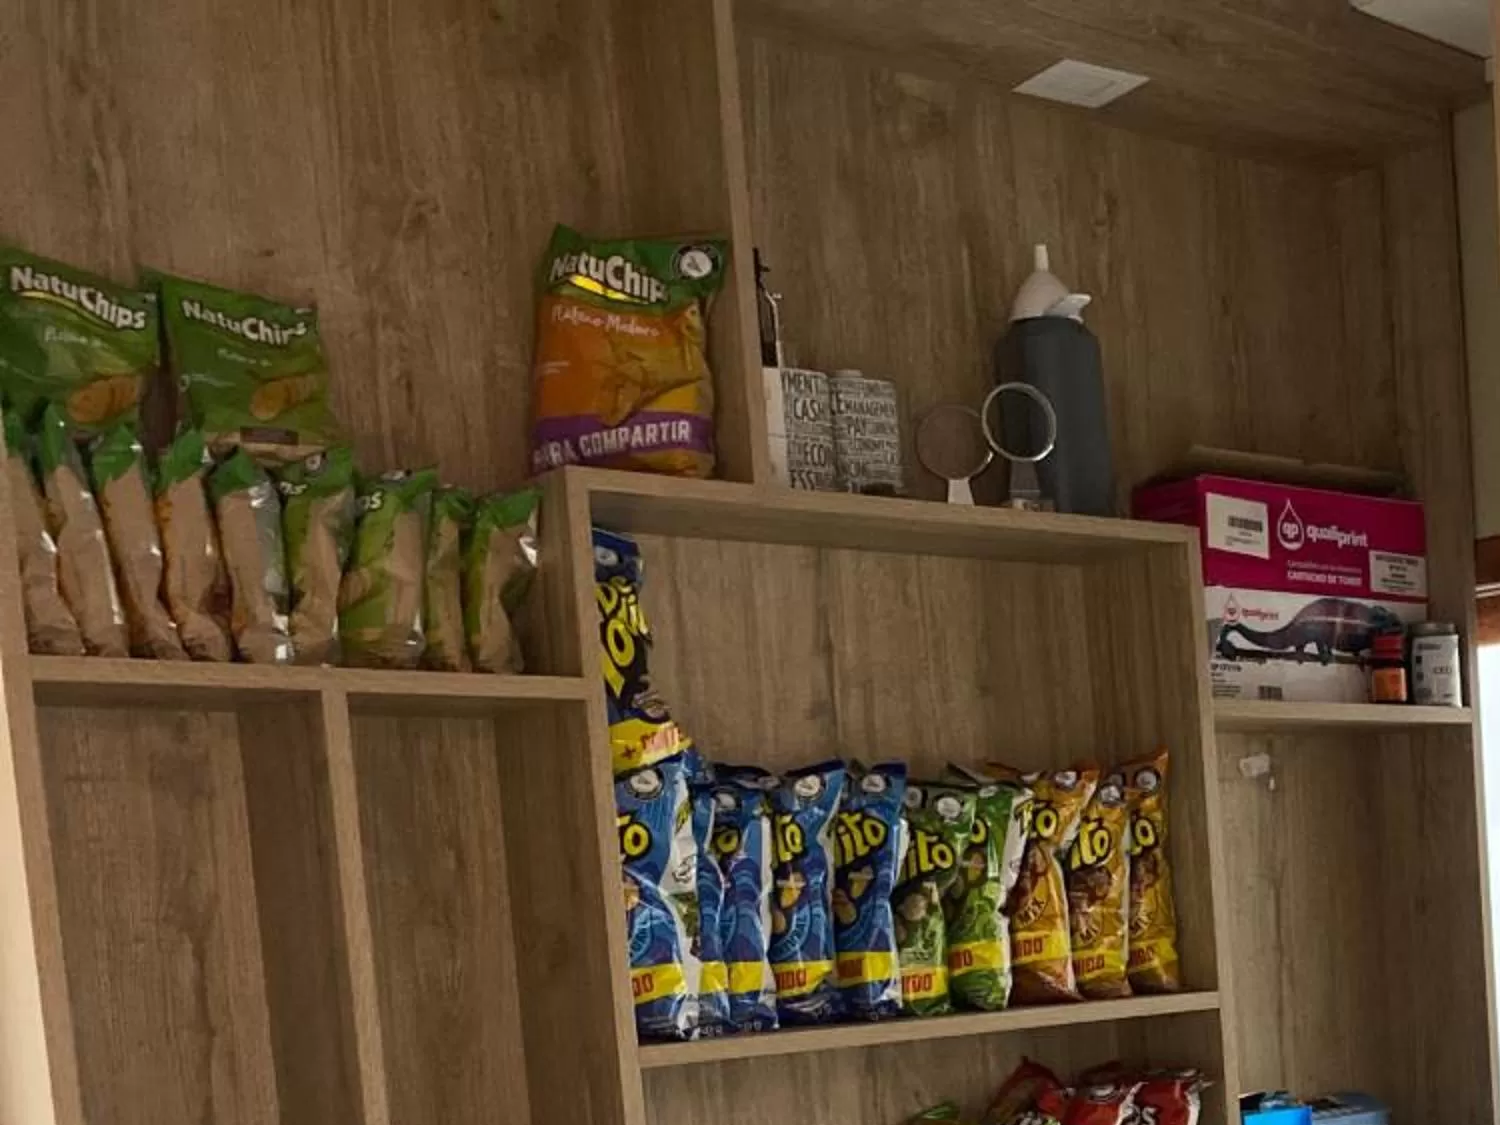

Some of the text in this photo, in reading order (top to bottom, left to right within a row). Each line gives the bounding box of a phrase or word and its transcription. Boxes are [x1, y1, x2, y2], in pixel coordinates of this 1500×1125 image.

[10, 266, 147, 330] NatuChips
[579, 419, 692, 457] COMPARTIR
[1306, 524, 1369, 549] qualiprint
